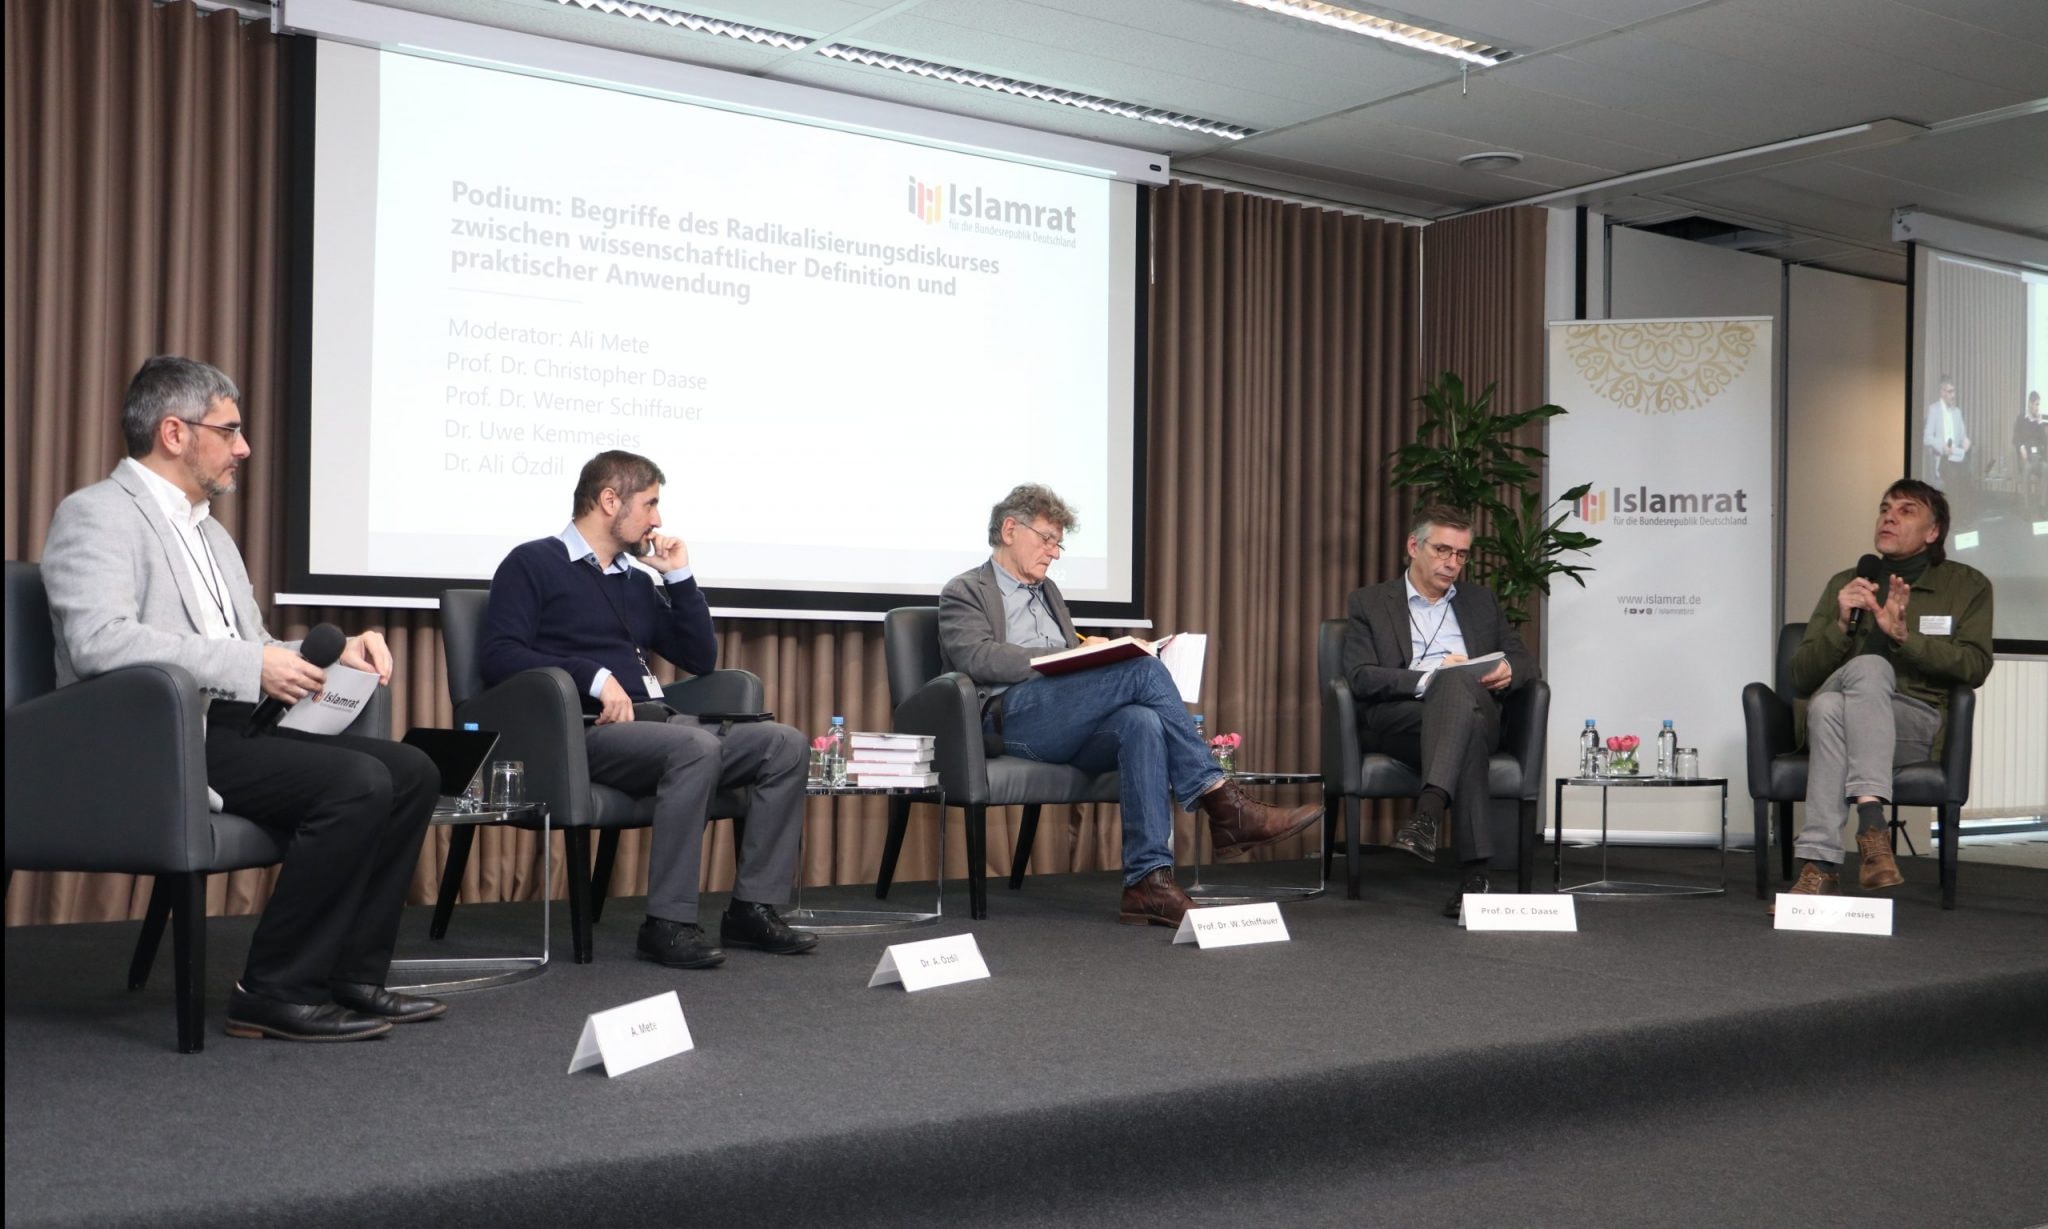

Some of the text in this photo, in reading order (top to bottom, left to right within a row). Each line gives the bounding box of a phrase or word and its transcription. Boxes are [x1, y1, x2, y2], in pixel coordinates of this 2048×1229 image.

[949, 183, 1077, 234] Islamrat
[451, 180, 1000, 275] Podium: Begriffe des Radikalisierungsdiskurses
[961, 220, 973, 233] die
[974, 223, 1032, 241] Bundesrepublik
[1032, 231, 1077, 249] Deutschland
[450, 216, 957, 297] zwischen wissenschaftlicher Definition und
[451, 248, 751, 305] praktischer Anwendung
[448, 317, 650, 354] Moderator: Ali Mete
[447, 351, 708, 391] Prof. Dr. Christopher Daase
[445, 385, 703, 421] Prof. Dr. Werner Schiffauer
[444, 419, 641, 449] Dr. Uwe Kemmesies
[444, 451, 565, 476] Dr. Ali Özdil
[1613, 486, 1748, 514] Islamrat
[1625, 516, 1638, 526] die
[1639, 516, 1698, 528] Bundesrepublik
[1699, 516, 1748, 526] Deutschland
[1616, 593, 1702, 605] www.islamrat.de
[324, 691, 361, 709] Islamrat
[1197, 922, 1217, 931] Prof.
[1217, 921, 1230, 930] Dr.
[1241, 917, 1279, 927] Schiffauer
[1481, 907, 1503, 915] Prof.
[1504, 907, 1518, 915] Dr.
[1531, 907, 1559, 915] Daase
[1792, 907, 1806, 915] Dr.
